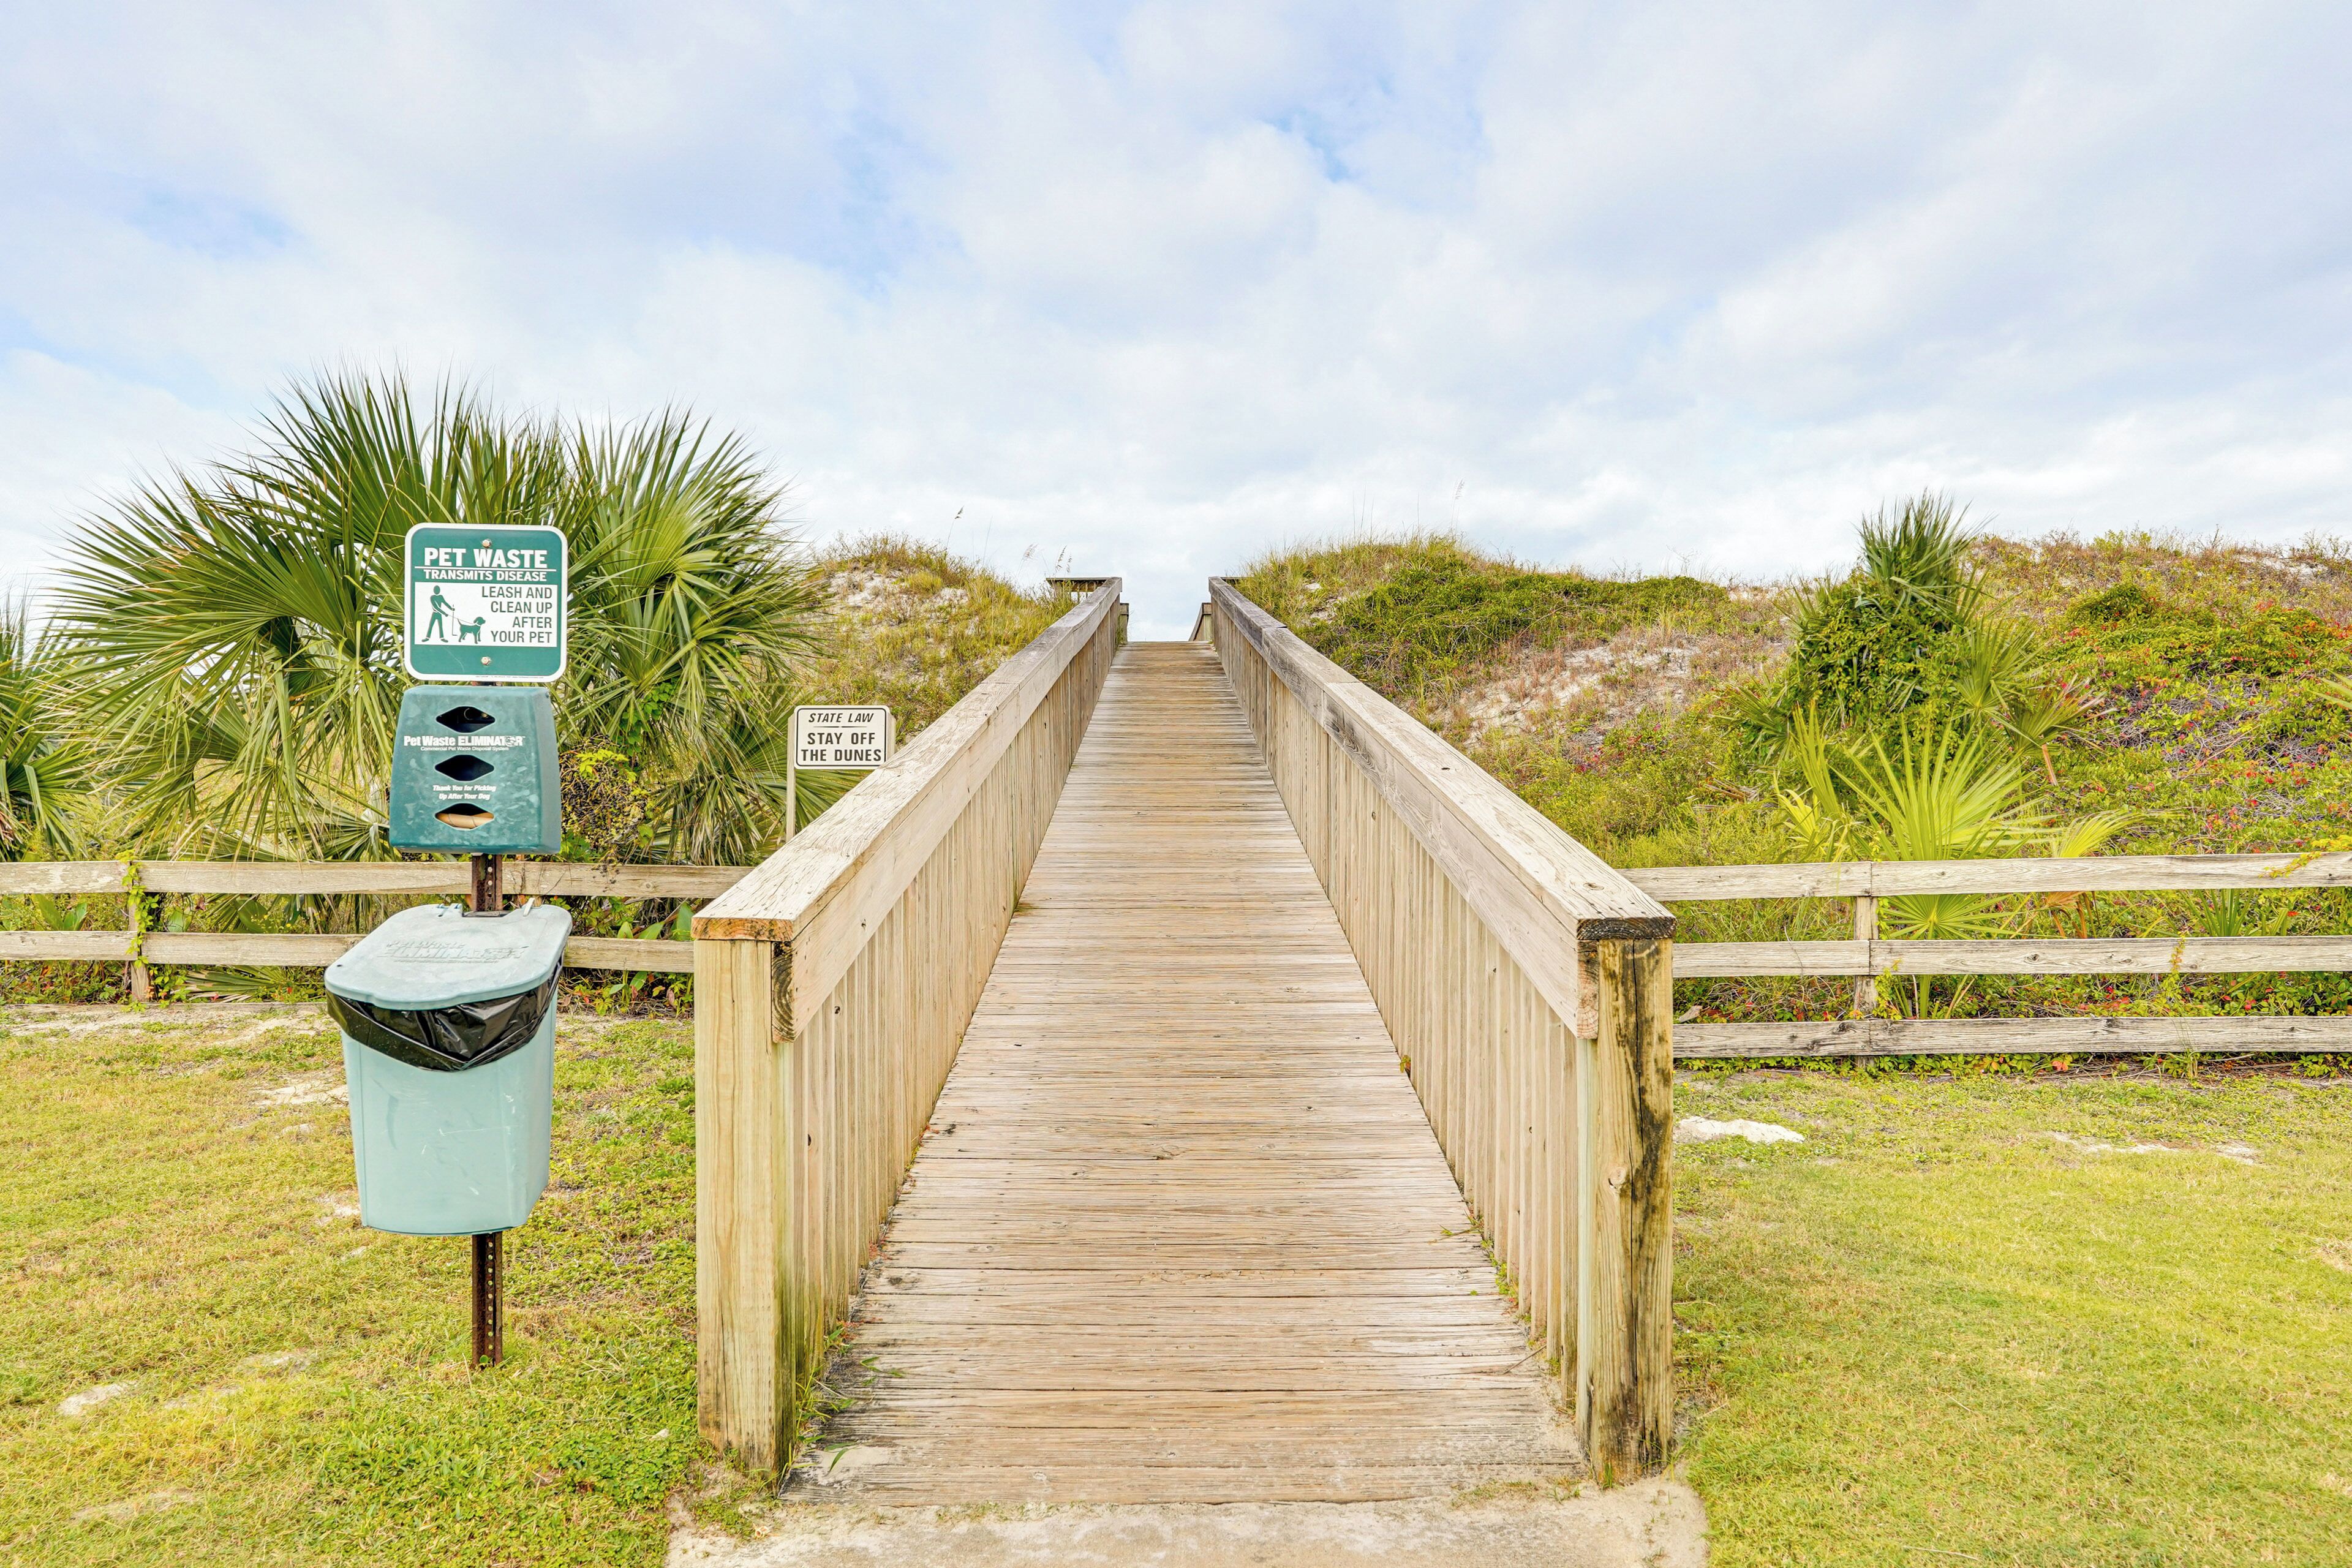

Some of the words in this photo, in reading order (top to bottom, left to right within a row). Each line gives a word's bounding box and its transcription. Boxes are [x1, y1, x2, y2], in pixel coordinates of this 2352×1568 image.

[424, 548, 466, 567] PET
[473, 548, 548, 568] WASTE
[424, 569, 492, 580] TRANSMITS
[496, 571, 547, 582] DISEASE
[481, 586, 522, 598] LEASH
[526, 587, 552, 598] AND
[491, 601, 532, 613] CLEAN
[536, 602, 552, 614] UP
[512, 616, 552, 628] AFTER
[491, 631, 524, 643] YOUR
[529, 631, 552, 643] PET
[809, 713, 843, 723] STATE
[848, 713, 874, 723] LAW
[404, 736, 421, 746] Pet
[421, 736, 456, 746] Waste
[807, 733, 843, 745] STAY
[851, 733, 875, 745] OFF
[801, 749, 827, 761] THE
[834, 749, 881, 761] DUNES
